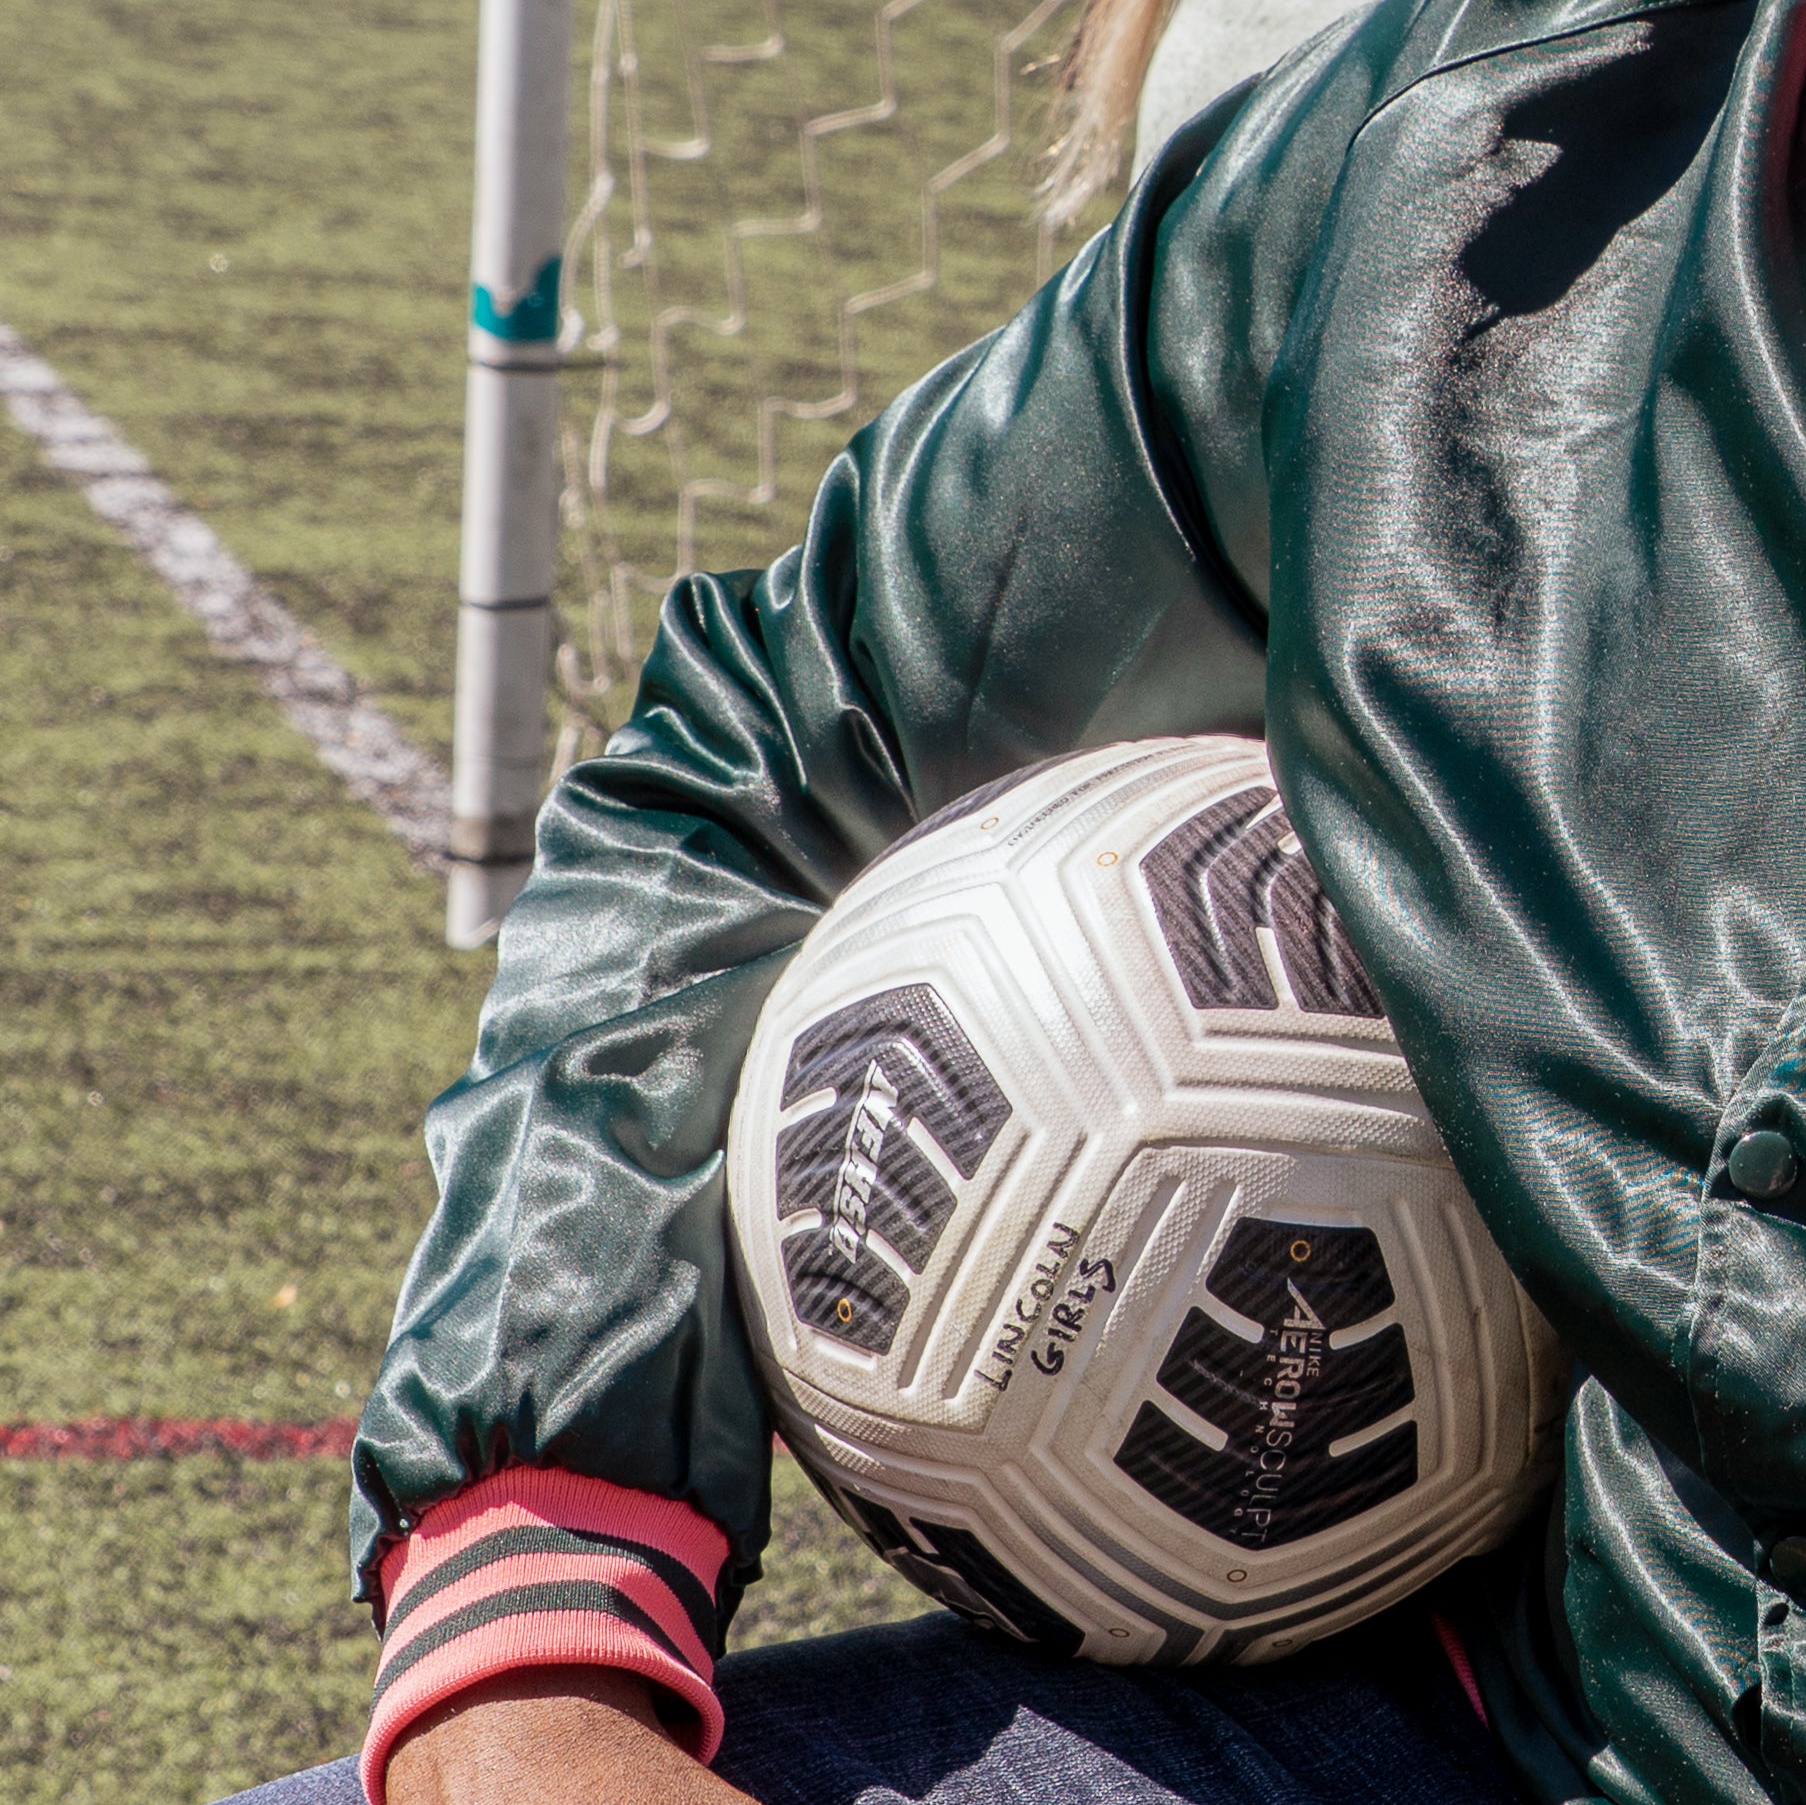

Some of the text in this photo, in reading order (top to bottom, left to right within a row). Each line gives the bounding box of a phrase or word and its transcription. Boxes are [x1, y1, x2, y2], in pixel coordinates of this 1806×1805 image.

[974, 1222, 1080, 1392] LINCOLN
[1031, 1258, 1116, 1376] GIRLS
[1306, 1332, 1322, 1378] NIKE
